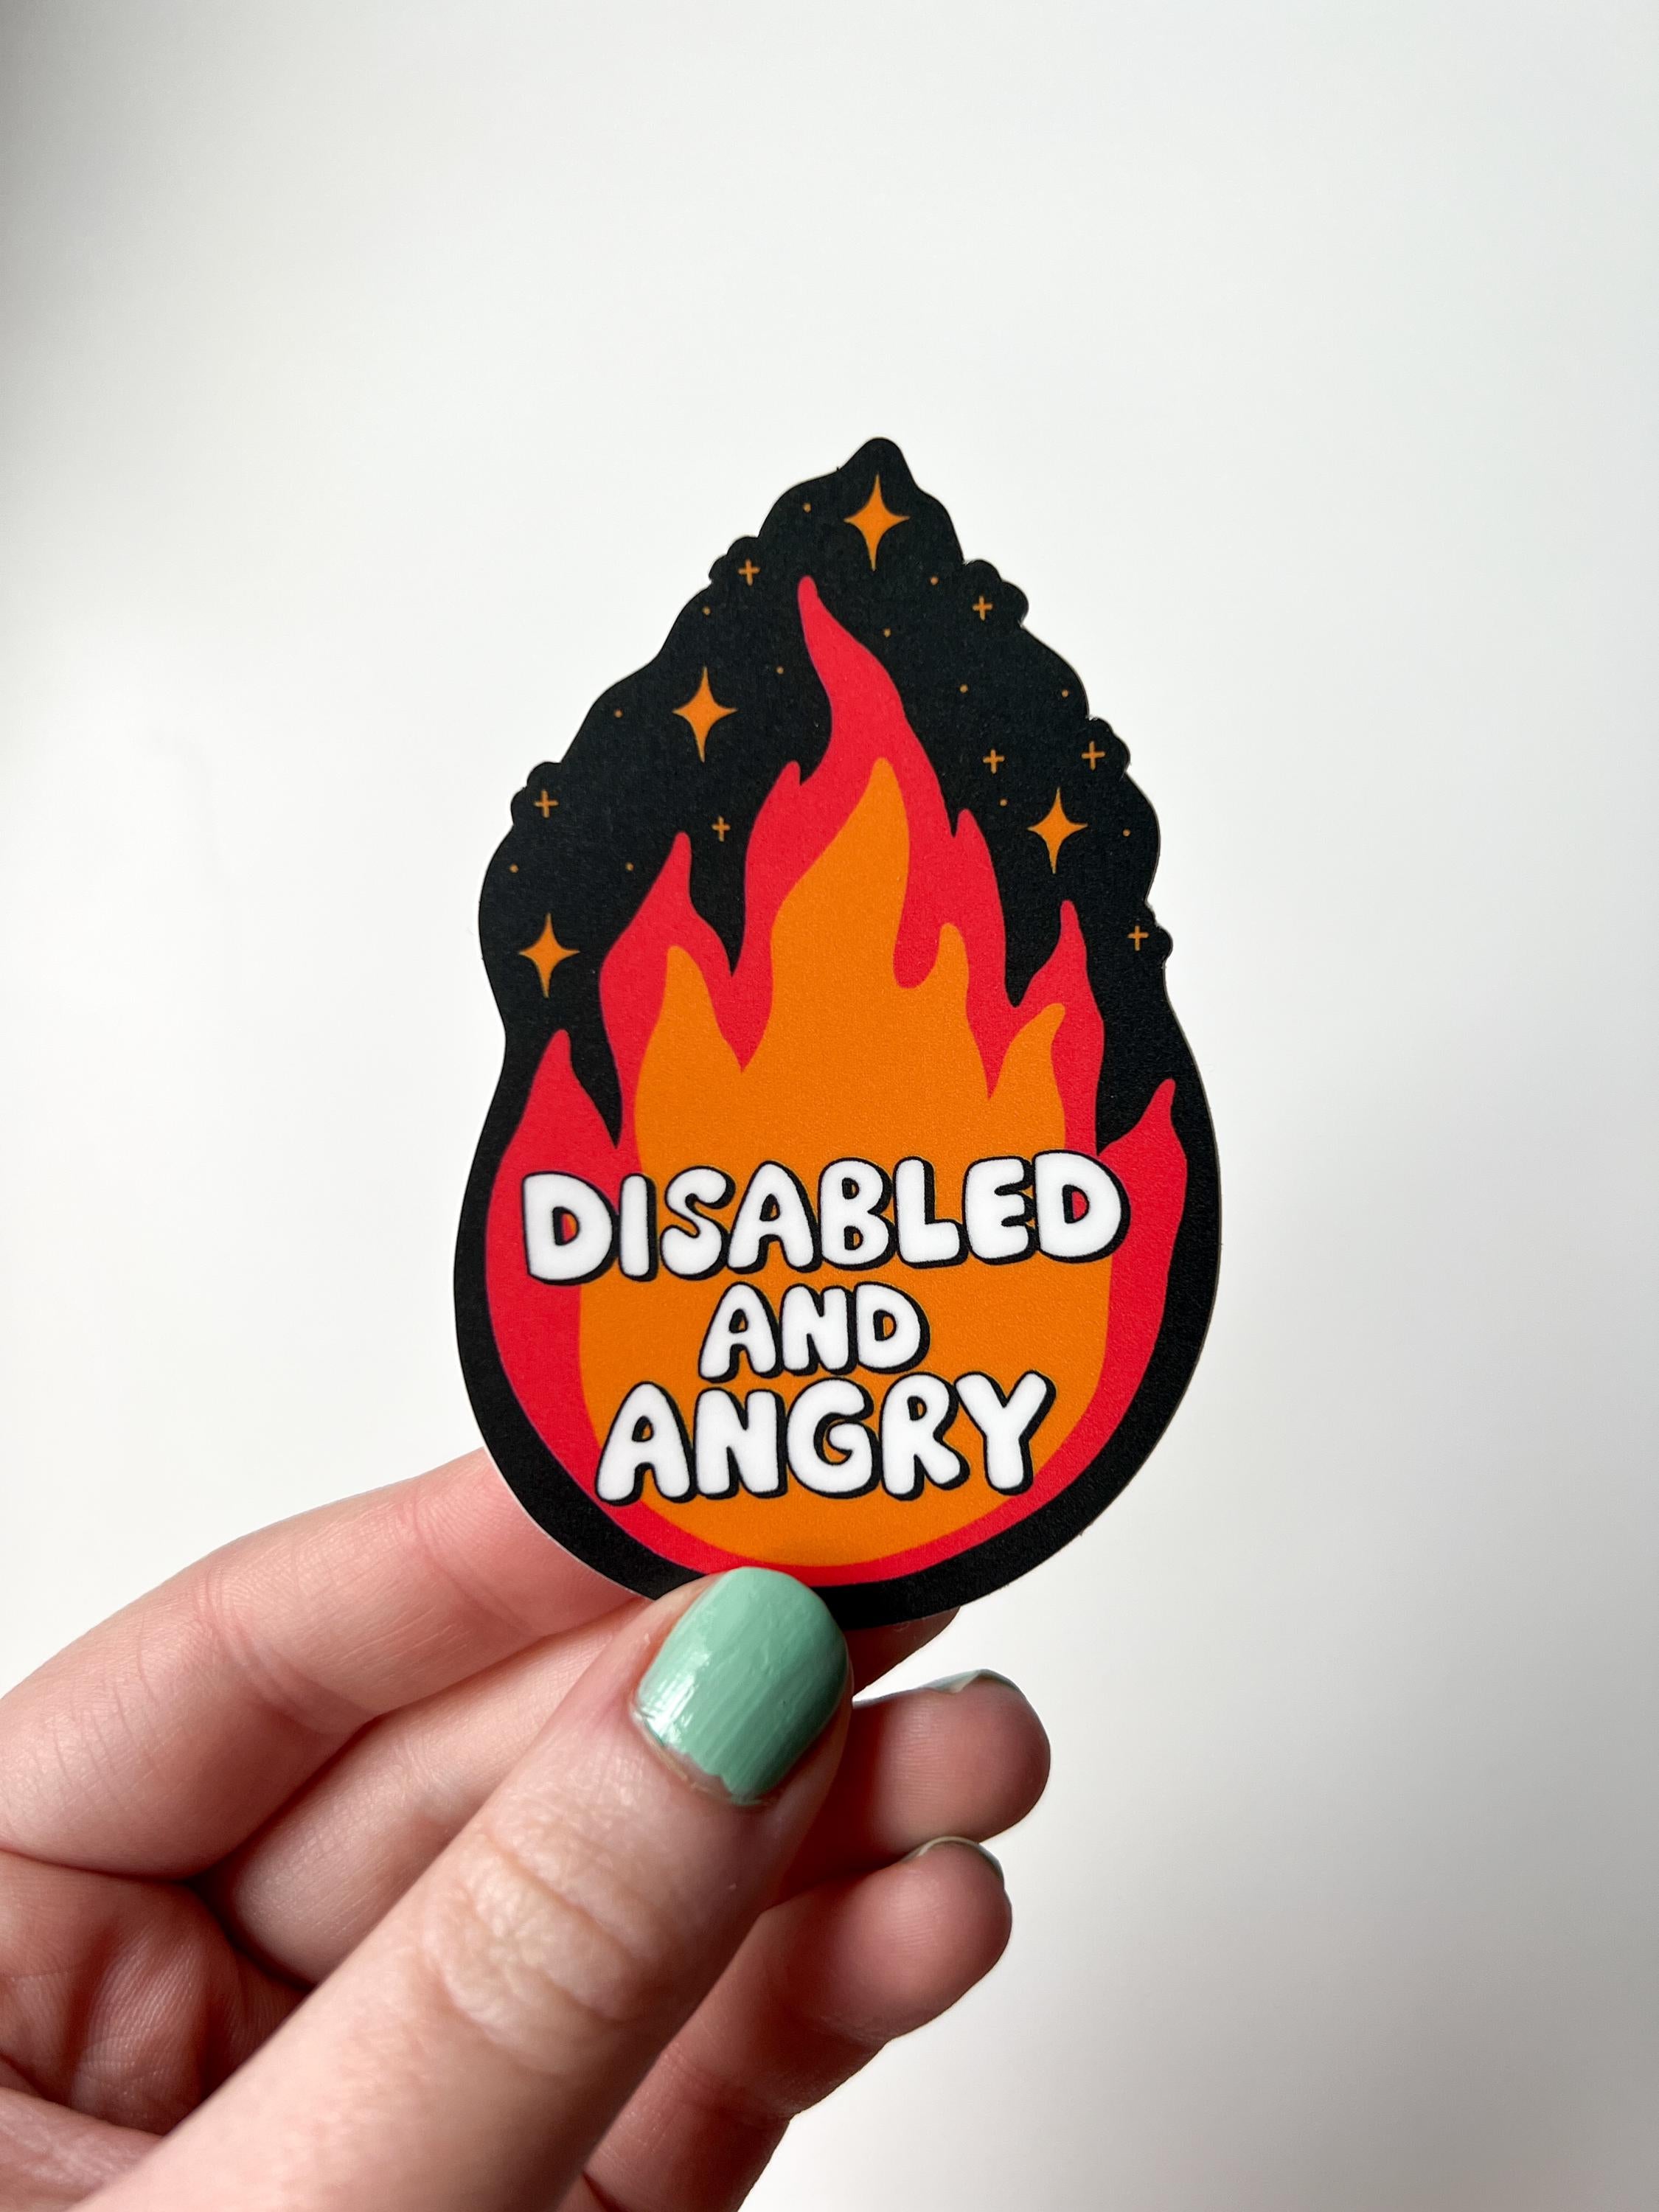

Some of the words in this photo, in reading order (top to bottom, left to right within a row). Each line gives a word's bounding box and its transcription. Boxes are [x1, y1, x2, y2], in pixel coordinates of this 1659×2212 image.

[522, 1151, 1128, 1283] DISABLED
[699, 1282, 928, 1380] AND
[596, 1372, 1054, 1503] ANGRY
